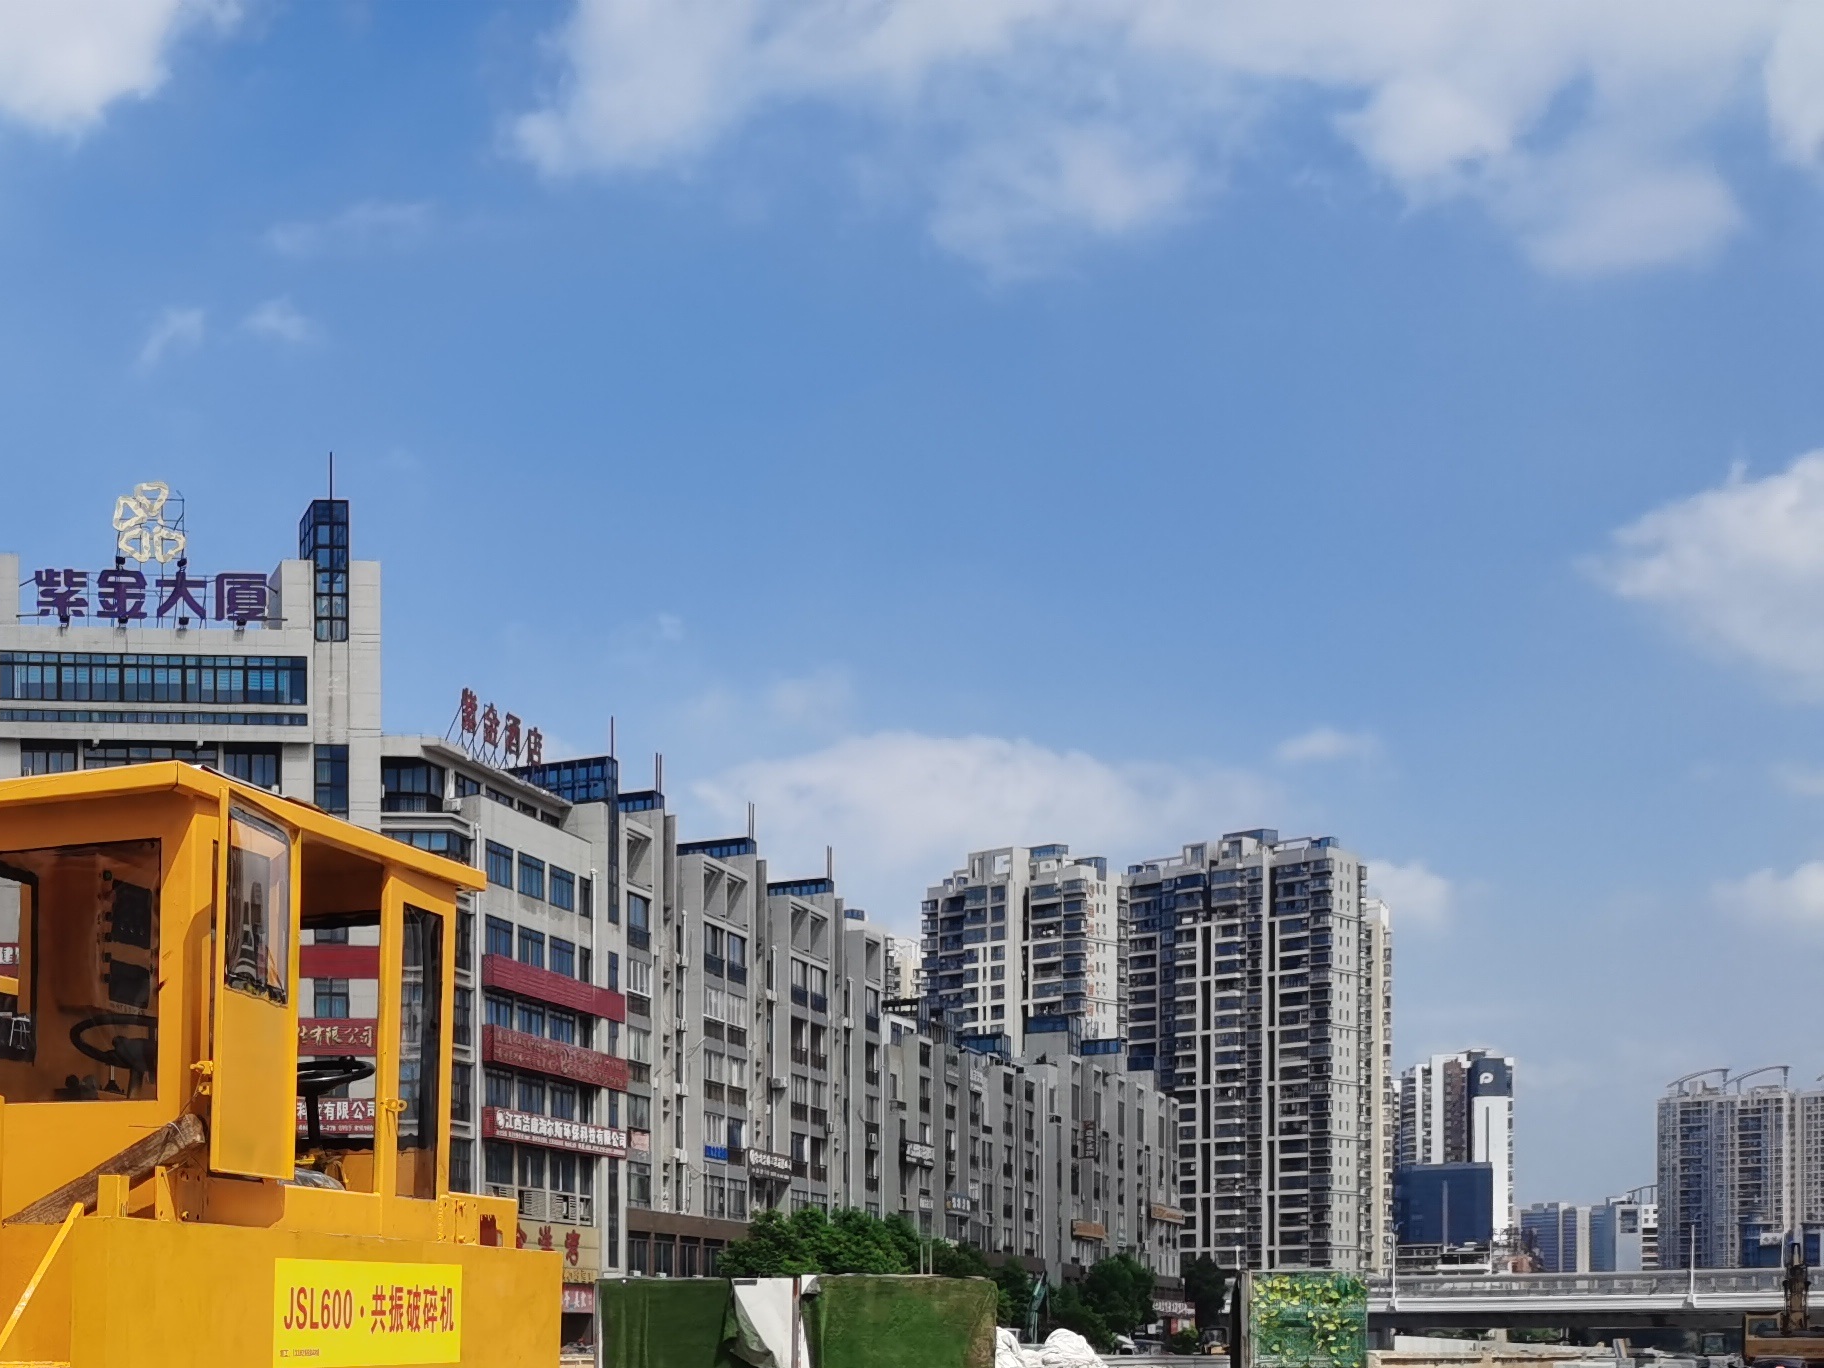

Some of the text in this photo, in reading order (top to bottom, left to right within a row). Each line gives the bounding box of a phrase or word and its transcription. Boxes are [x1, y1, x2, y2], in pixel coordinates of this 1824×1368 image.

[34, 568, 268, 622] 紫金大厦
[461, 687, 543, 767] 紫金酒店
